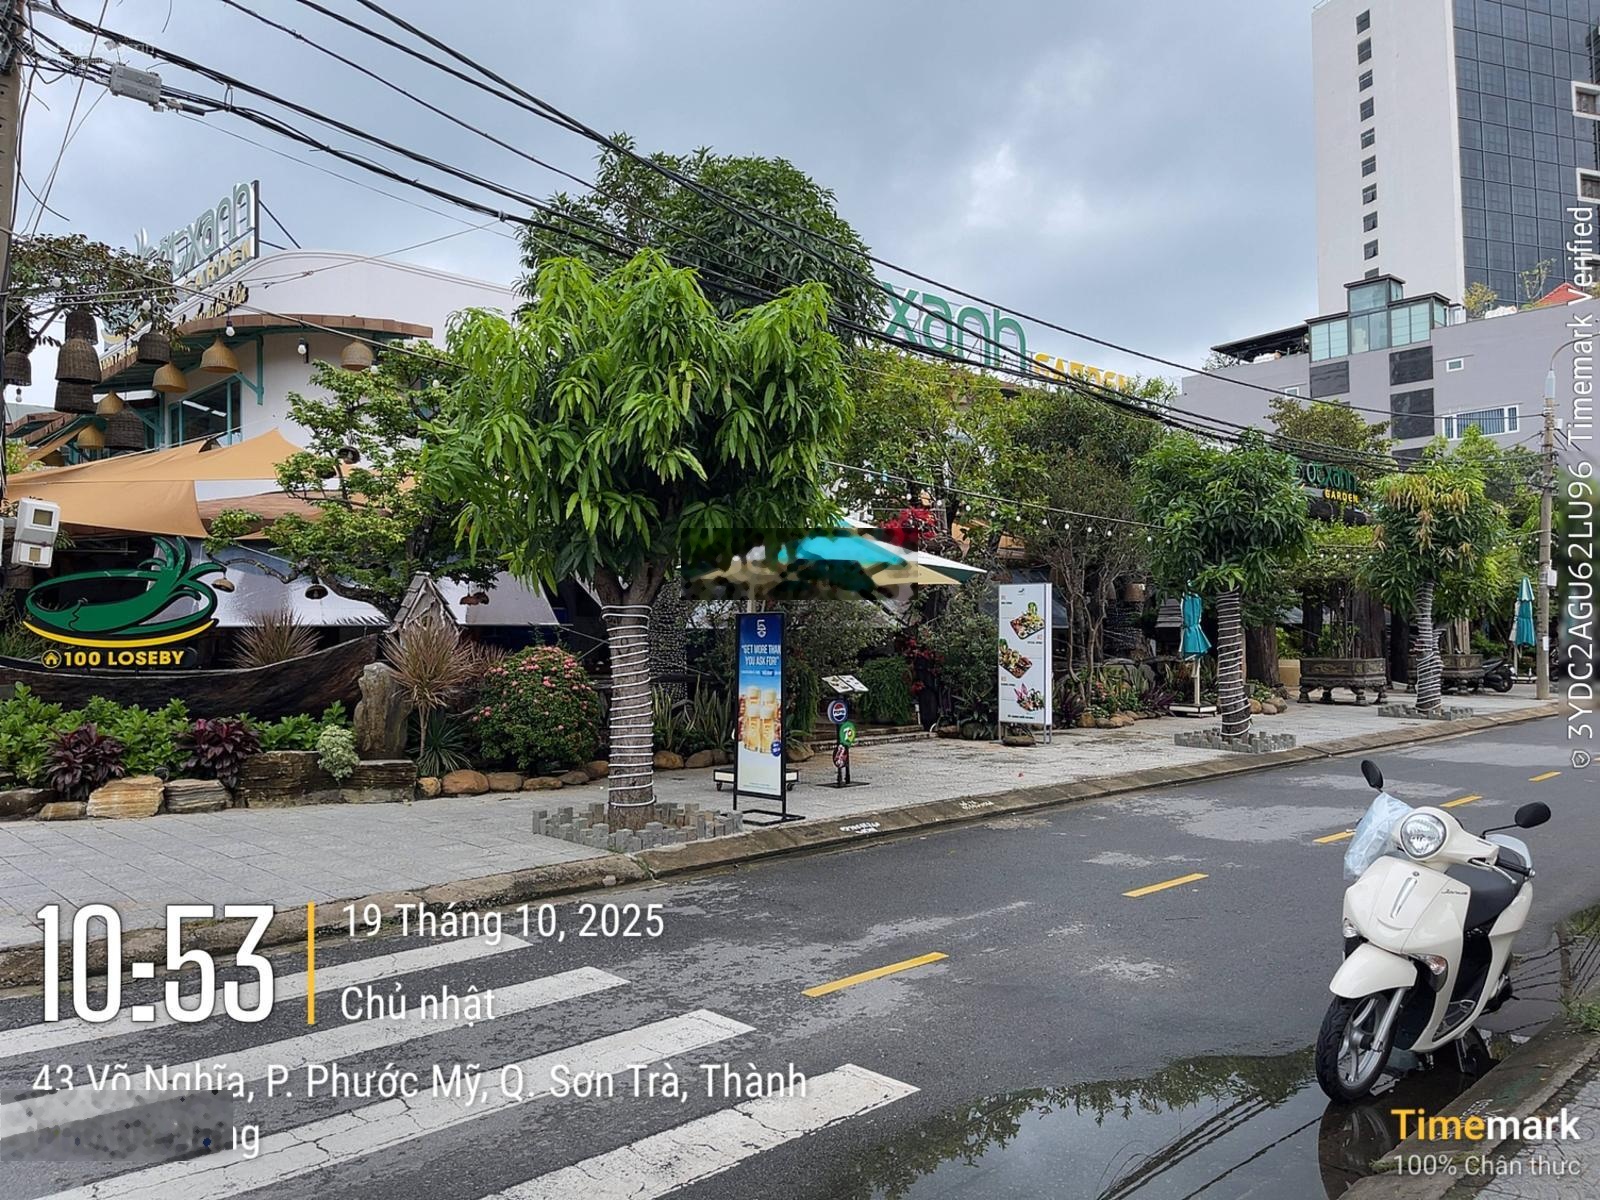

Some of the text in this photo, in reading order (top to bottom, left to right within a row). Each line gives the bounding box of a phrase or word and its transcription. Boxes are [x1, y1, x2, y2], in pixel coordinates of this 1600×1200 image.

[1324, 488, 1360, 503] GARDEN
[64, 651, 185, 666] 100 LOSEBY
